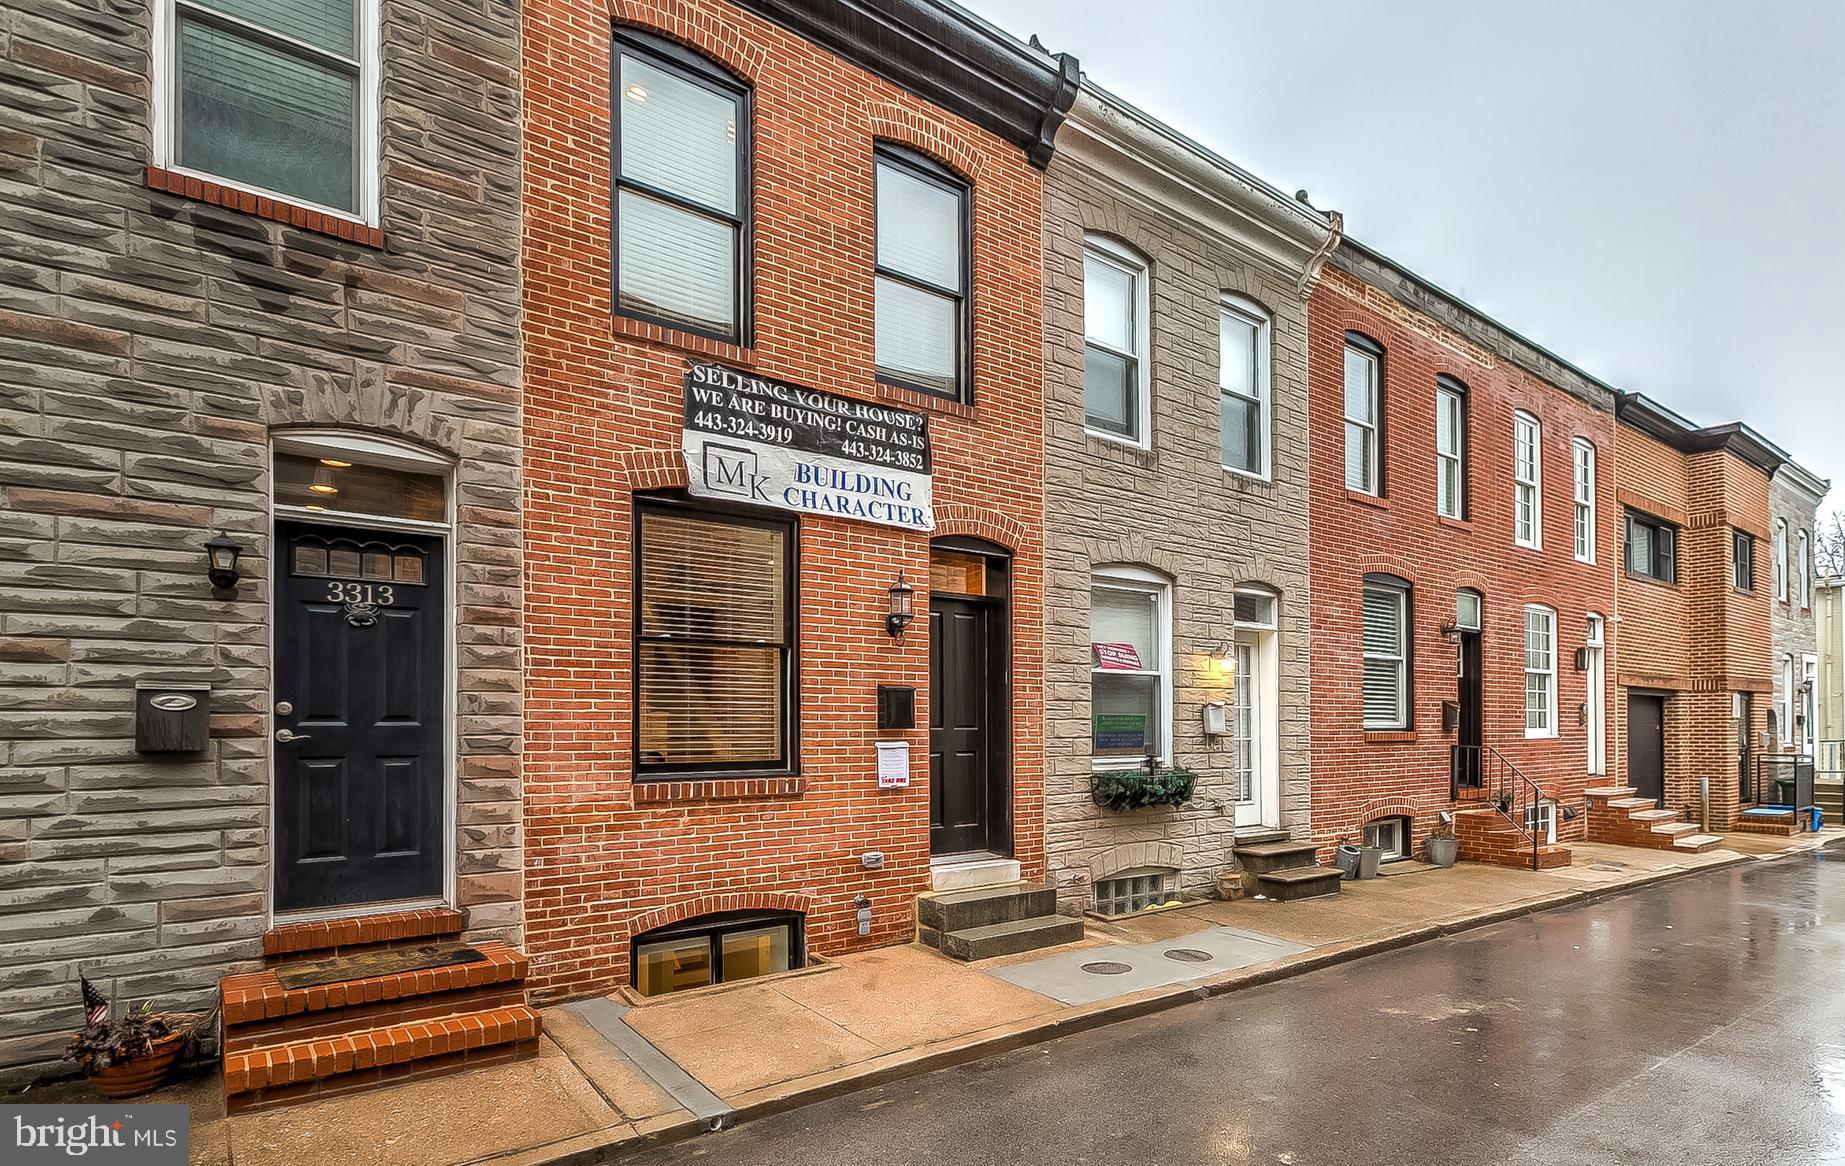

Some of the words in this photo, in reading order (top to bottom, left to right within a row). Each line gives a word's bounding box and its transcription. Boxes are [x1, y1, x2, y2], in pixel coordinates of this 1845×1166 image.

[692, 387, 724, 407] WE
[728, 394, 766, 416] ARE
[770, 403, 841, 431] BUYING!
[846, 420, 887, 441] CASH
[889, 431, 925, 450] AS-IS
[693, 365, 789, 401] SELLING
[795, 390, 851, 416] YOUR
[855, 403, 923, 431] HOUSE?
[694, 410, 793, 444] 443-324-3919
[841, 439, 924, 470] 443-324-3852
[783, 486, 926, 525] CHARACTER
[794, 462, 912, 501] BUILDING
[326, 581, 394, 606] 3313
